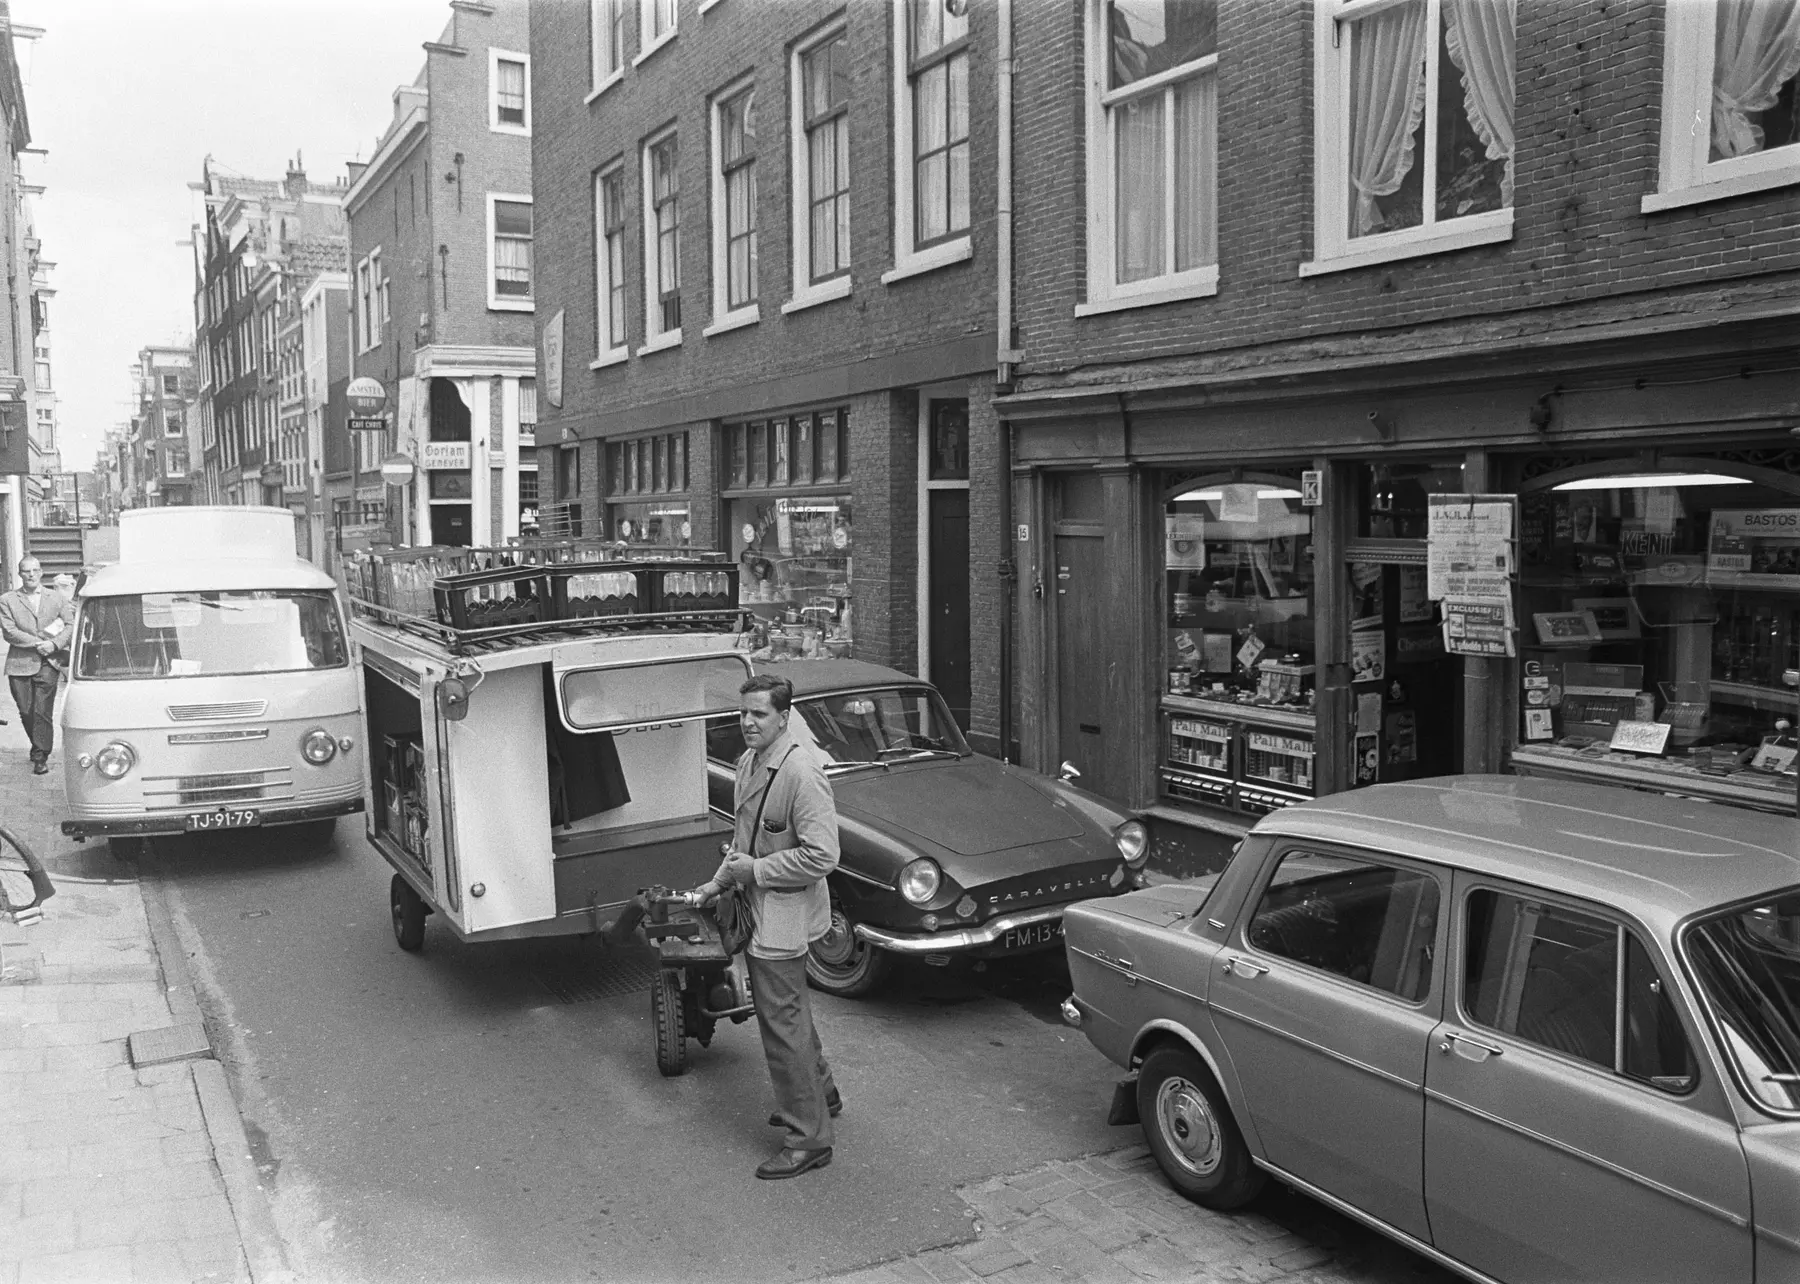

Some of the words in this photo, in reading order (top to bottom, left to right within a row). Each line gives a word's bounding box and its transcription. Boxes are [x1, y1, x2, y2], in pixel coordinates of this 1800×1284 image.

[425, 459, 464, 467] GENEVER
[1304, 483, 1317, 499] K
[1744, 514, 1797, 526] BASTOS
[1019, 527, 1027, 539] 15
[1622, 531, 1676, 557] KENT
[1717, 557, 1745, 567] BASTOS
[1175, 719, 1197, 733] Pall
[1201, 722, 1228, 737] Mall
[1253, 734, 1278, 748] Pall
[1282, 737, 1313, 752] Mall
[191, 810, 254, 829] TJ-91-79
[989, 873, 1109, 904] CARAVELLE
[1005, 922, 1065, 949] FM-13-4
